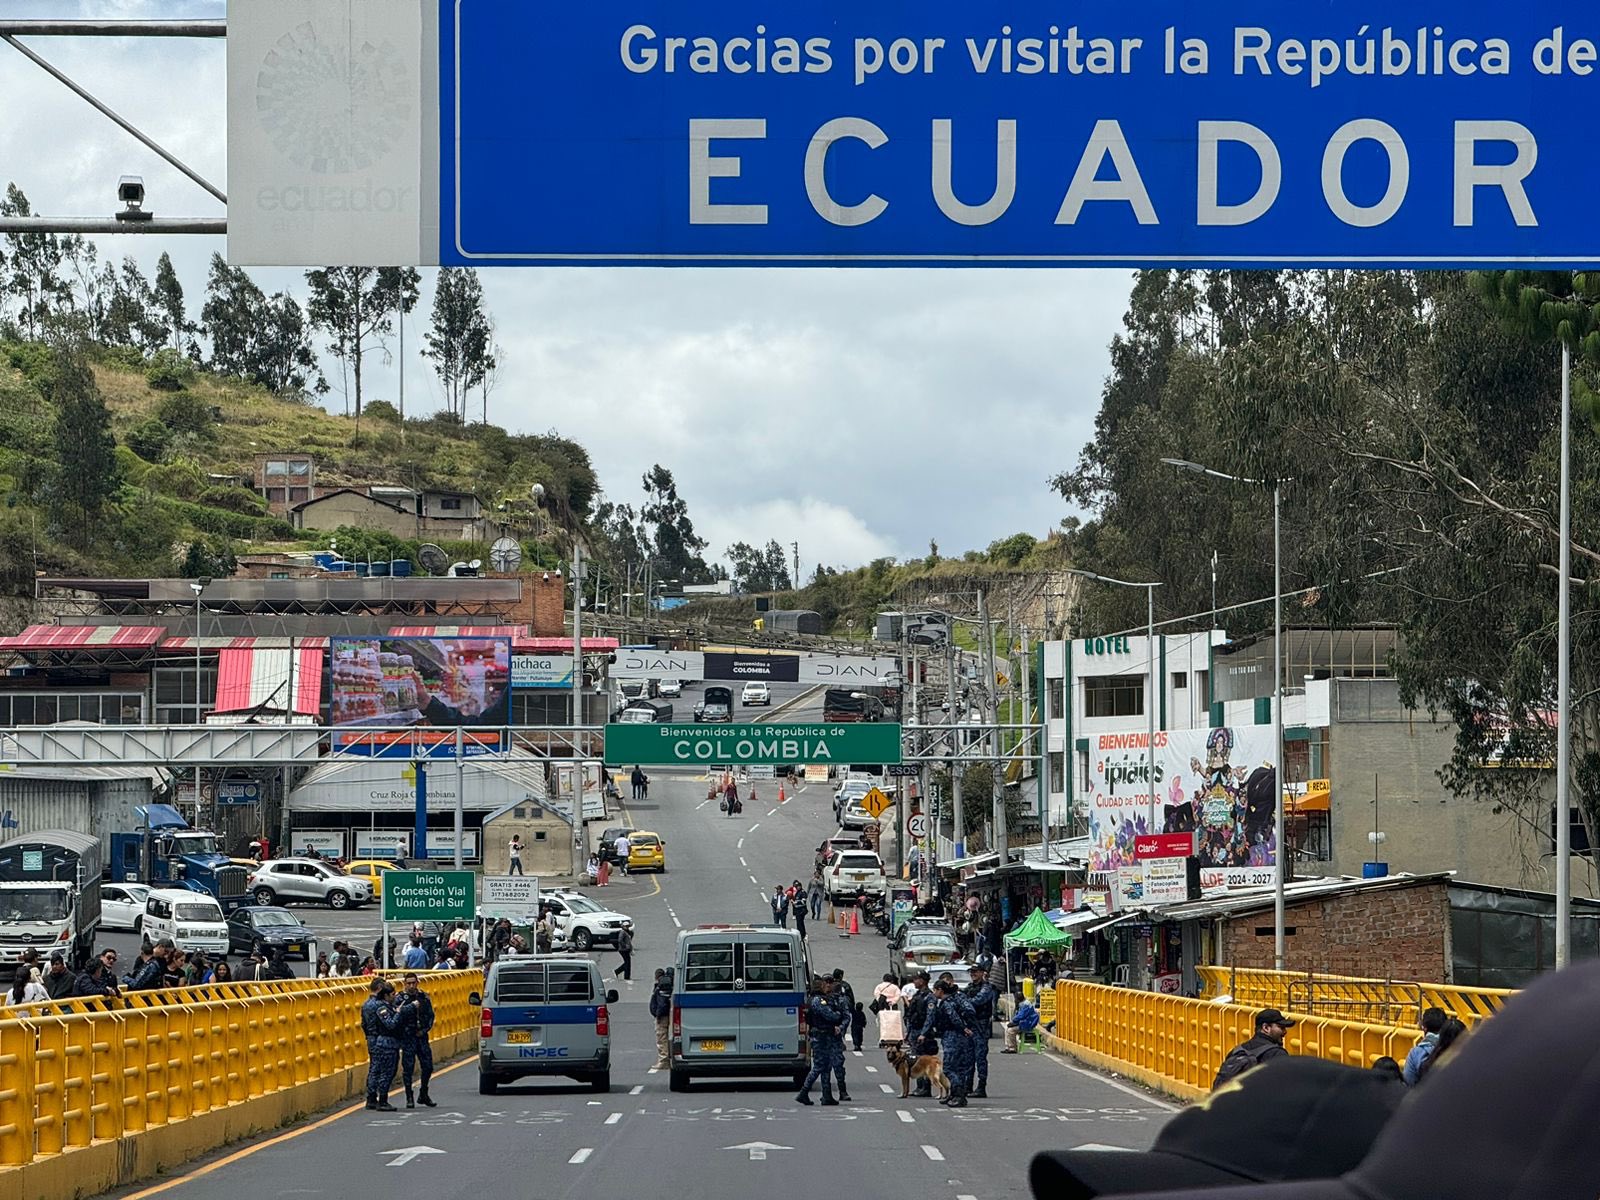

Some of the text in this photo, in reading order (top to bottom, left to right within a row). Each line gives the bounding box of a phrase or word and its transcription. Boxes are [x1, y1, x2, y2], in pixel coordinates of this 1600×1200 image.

[620, 25, 1598, 88] Gracias por visitar la República de
[689, 117, 1539, 227] ECUADOR
[256, 178, 416, 212] ecuador
[1084, 635, 1131, 656] HOTEL
[625, 658, 687, 671] DIAN
[816, 664, 878, 677] DIAN
[660, 727, 846, 739] Bienvenidos a la República de
[674, 740, 832, 759] COLOMBIA
[1097, 760, 1104, 773] a
[370, 790, 456, 801] Cruz Roja Combiana
[1134, 793, 1162, 806] TODS
[1137, 843, 1157, 853] Claro
[415, 874, 445, 885] Inicio
[1227, 874, 1247, 885] 2024
[1252, 873, 1271, 885] 2027
[392, 886, 466, 896] Concesión Vial
[396, 898, 465, 908] Unión Del Sur
[519, 1045, 568, 1058] INPEC
[754, 1042, 784, 1050] INPEC
[365, 1117, 563, 1126] SOLO
